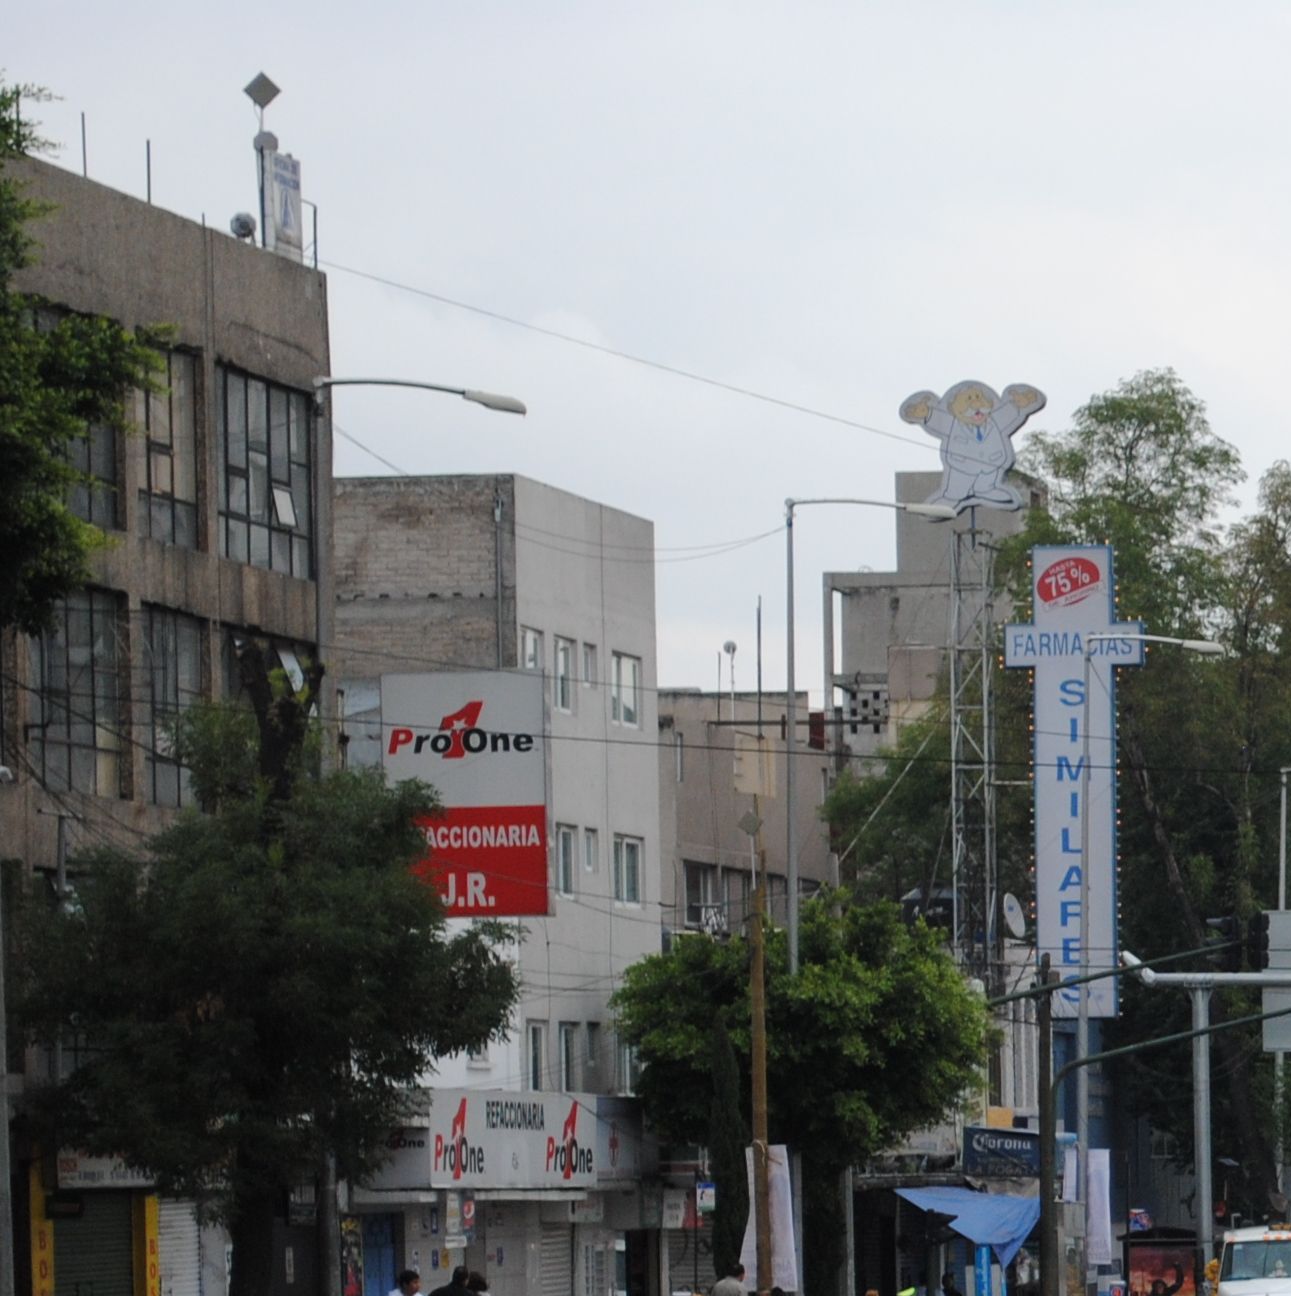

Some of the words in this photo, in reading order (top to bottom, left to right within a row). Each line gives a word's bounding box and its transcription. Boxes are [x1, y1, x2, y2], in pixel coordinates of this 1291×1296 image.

[1044, 565, 1090, 597] 75%
[1013, 632, 1133, 657] FARMACIAS
[424, 824, 540, 848] ACCIONARIA
[441, 872, 496, 907] J.R.
[486, 1100, 545, 1131] REFACCIONARIA
[971, 1132, 1032, 1154] Corona
